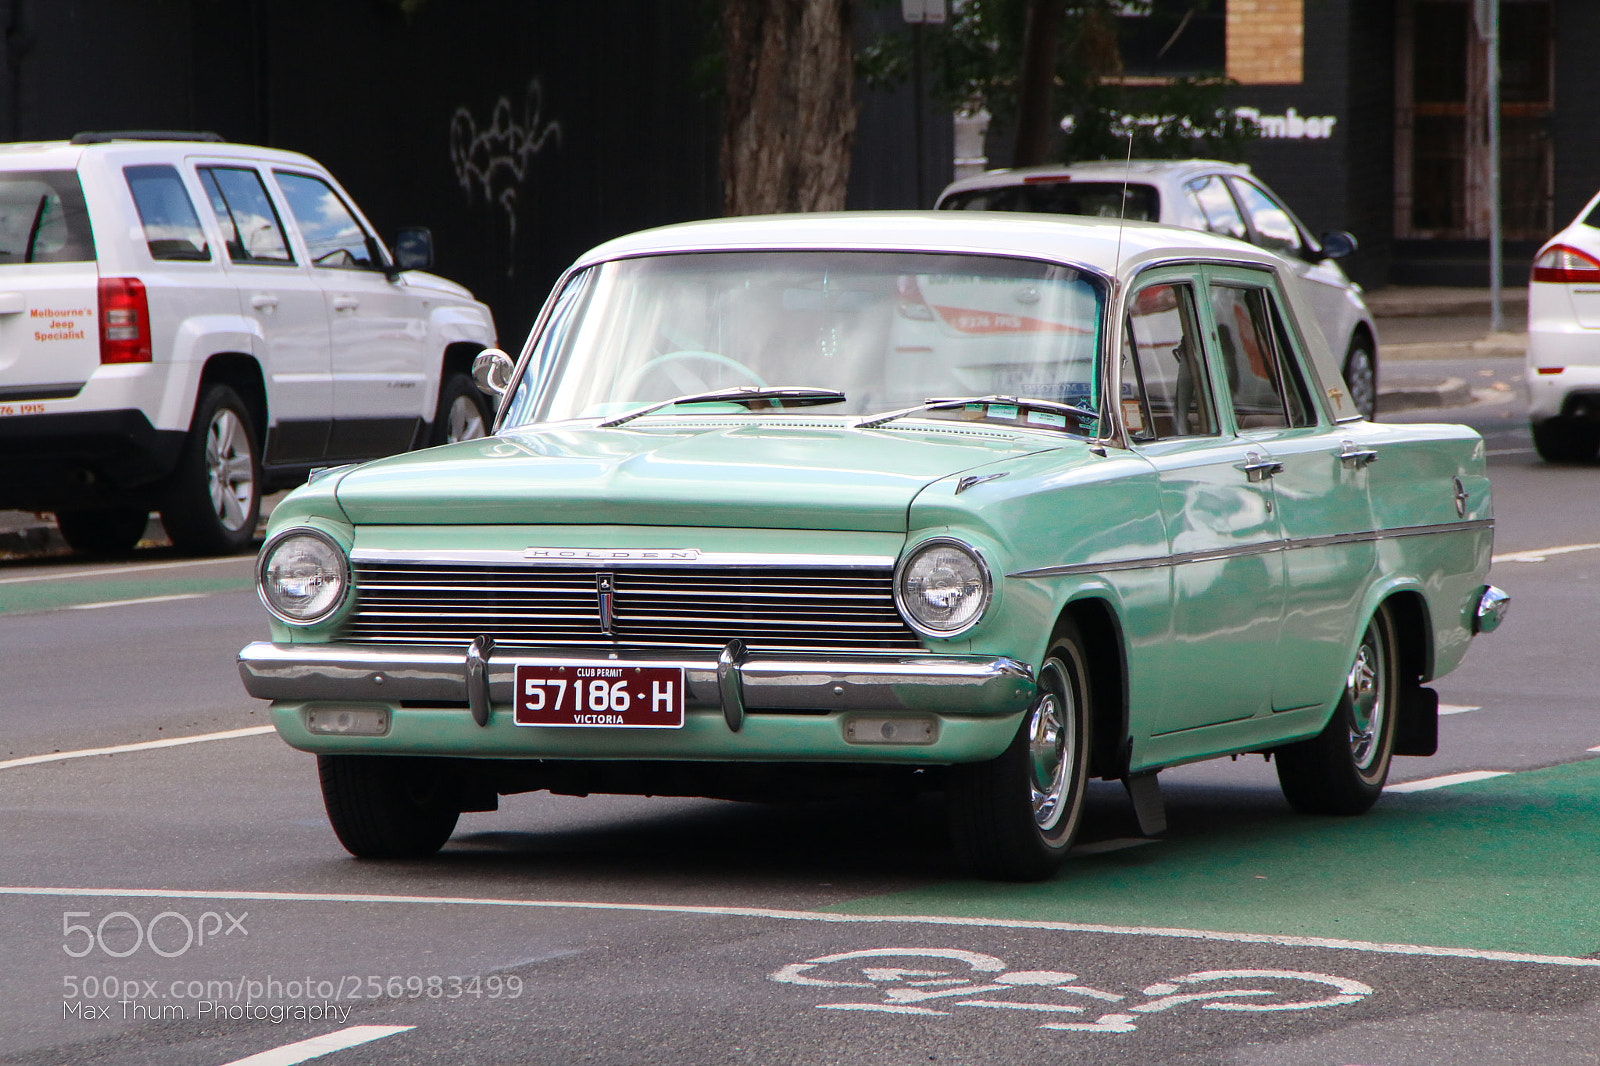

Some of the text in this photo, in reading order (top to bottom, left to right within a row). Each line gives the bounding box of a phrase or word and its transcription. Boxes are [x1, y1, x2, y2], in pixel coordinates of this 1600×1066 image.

[30, 308, 92, 318] Melbourne's
[49, 320, 75, 329] Jeep
[34, 330, 84, 342] Specialist
[20, 404, 45, 414] 1915
[576, 668, 623, 677] CLUB PERMIT
[573, 714, 624, 724] VICTORIA
